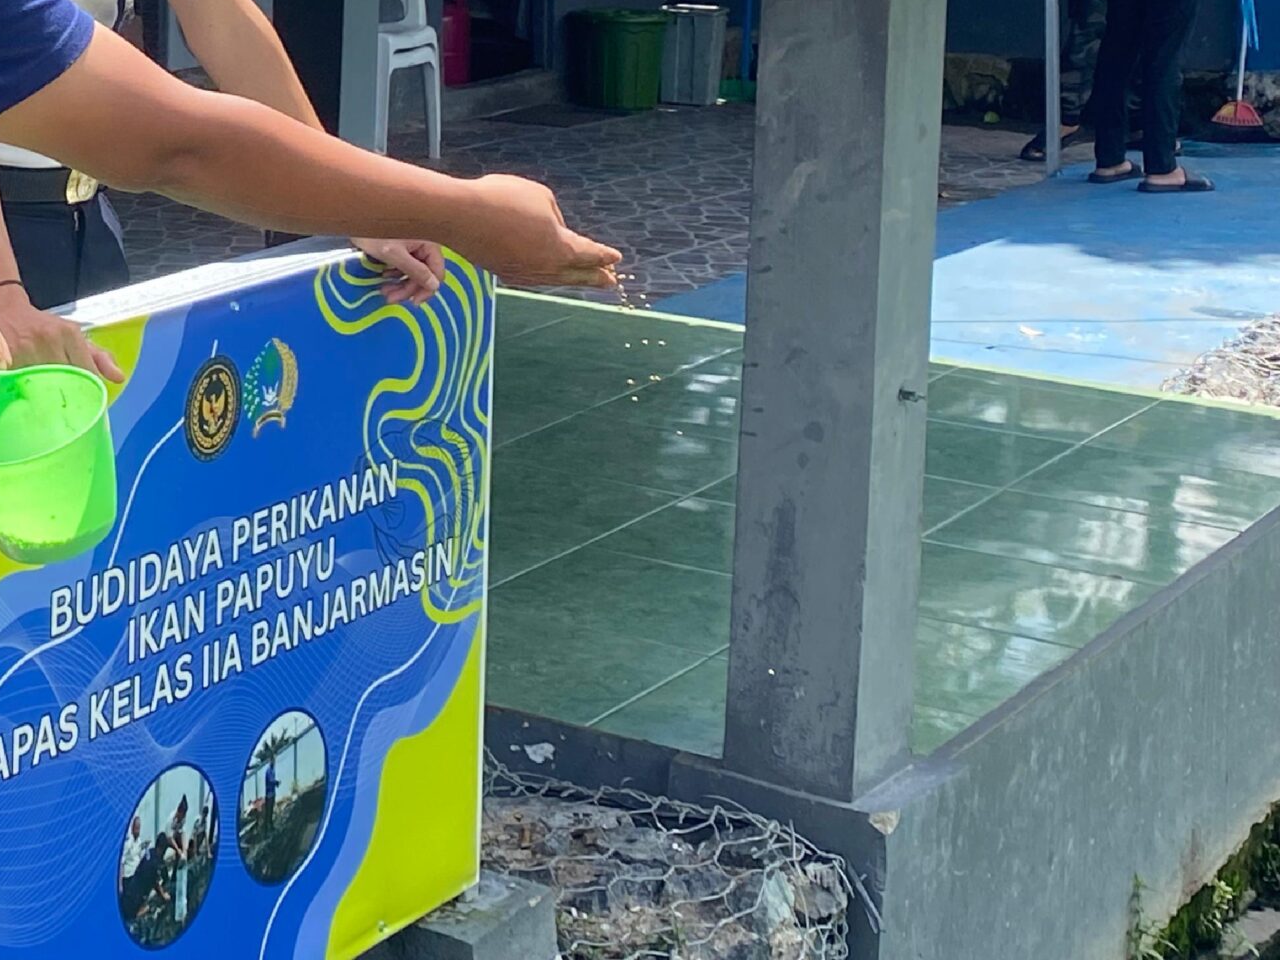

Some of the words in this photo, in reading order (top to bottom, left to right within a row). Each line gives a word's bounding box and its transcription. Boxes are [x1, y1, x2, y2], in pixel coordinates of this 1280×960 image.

[49, 526, 223, 638] BUDIDAYA
[231, 458, 399, 566] PERIKANAN
[88, 652, 194, 740] KELAS
[201, 632, 243, 688] IIA
[250, 536, 456, 664] BANJARMASIN
[126, 589, 206, 665] IKAN
[214, 536, 337, 628] PAPUYU
